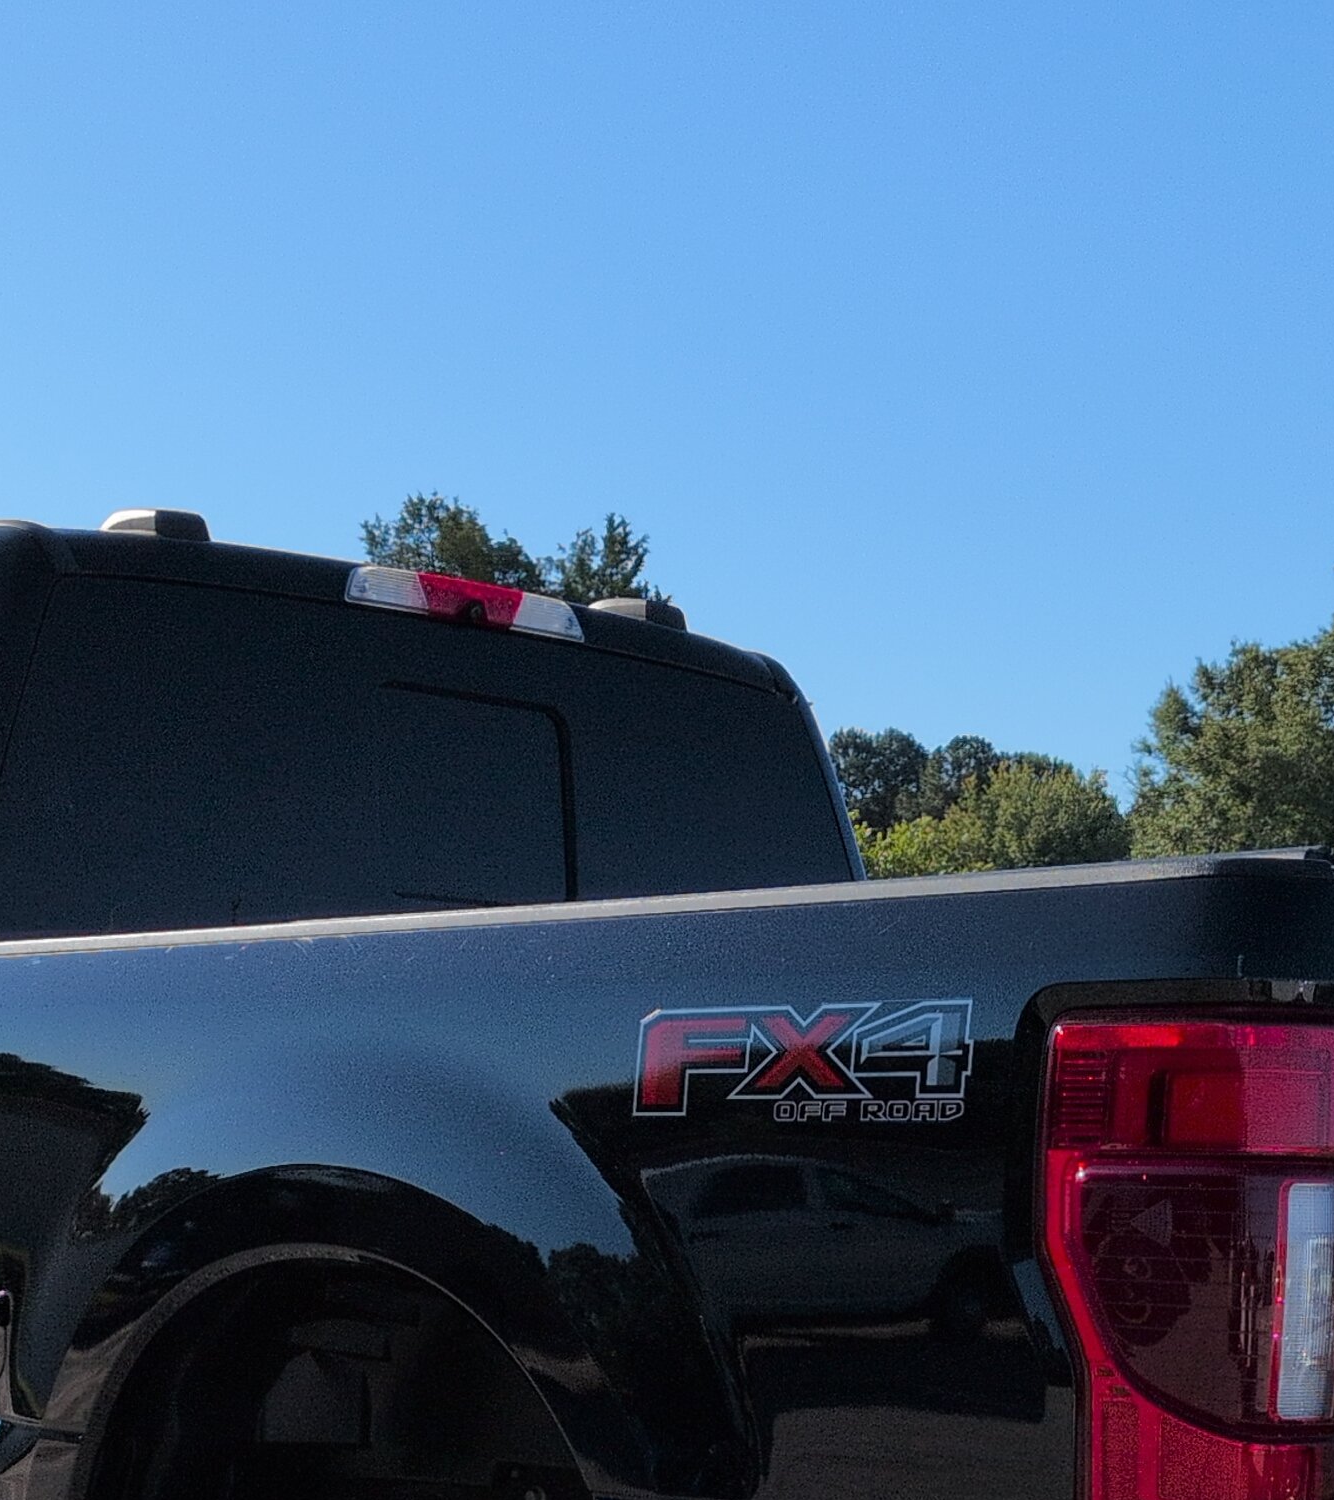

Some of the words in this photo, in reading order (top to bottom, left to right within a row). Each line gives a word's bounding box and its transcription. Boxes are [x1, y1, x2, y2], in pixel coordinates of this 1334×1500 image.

[632, 999, 974, 1116] FX4
[773, 1101, 847, 1122] OFF
[860, 1100, 965, 1121] ROAD
